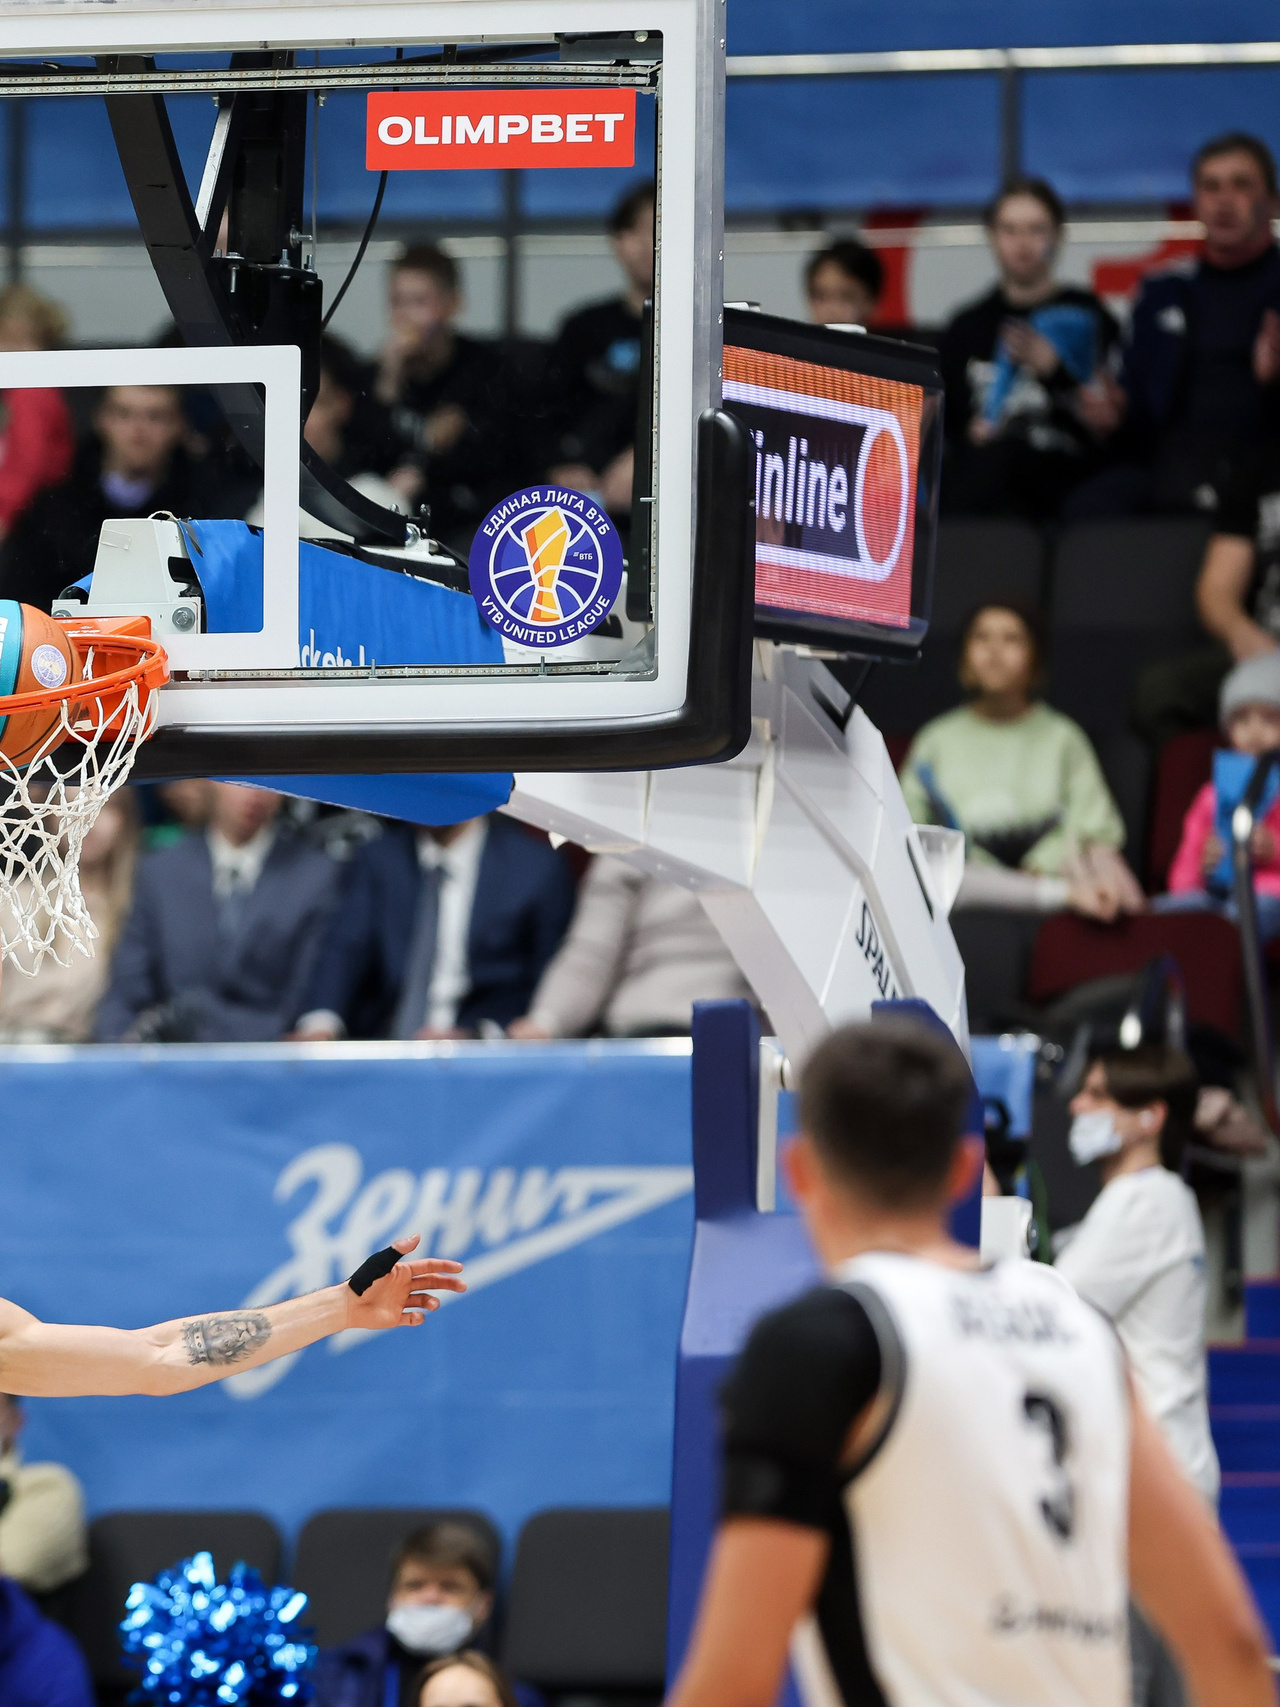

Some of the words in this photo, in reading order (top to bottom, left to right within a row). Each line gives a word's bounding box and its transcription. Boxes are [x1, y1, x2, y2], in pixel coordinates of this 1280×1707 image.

[377, 113, 625, 146] OLIMPBET
[750, 428, 848, 534] inline
[483, 490, 541, 538] ЕДИНАЯ
[544, 490, 585, 512] ЛИГА
[585, 506, 611, 537] ВТБ
[481, 595, 504, 625] VTB
[502, 623, 556, 643] UNITED
[559, 595, 611, 641] LEAGUE
[855, 899, 897, 1000] SPAL
